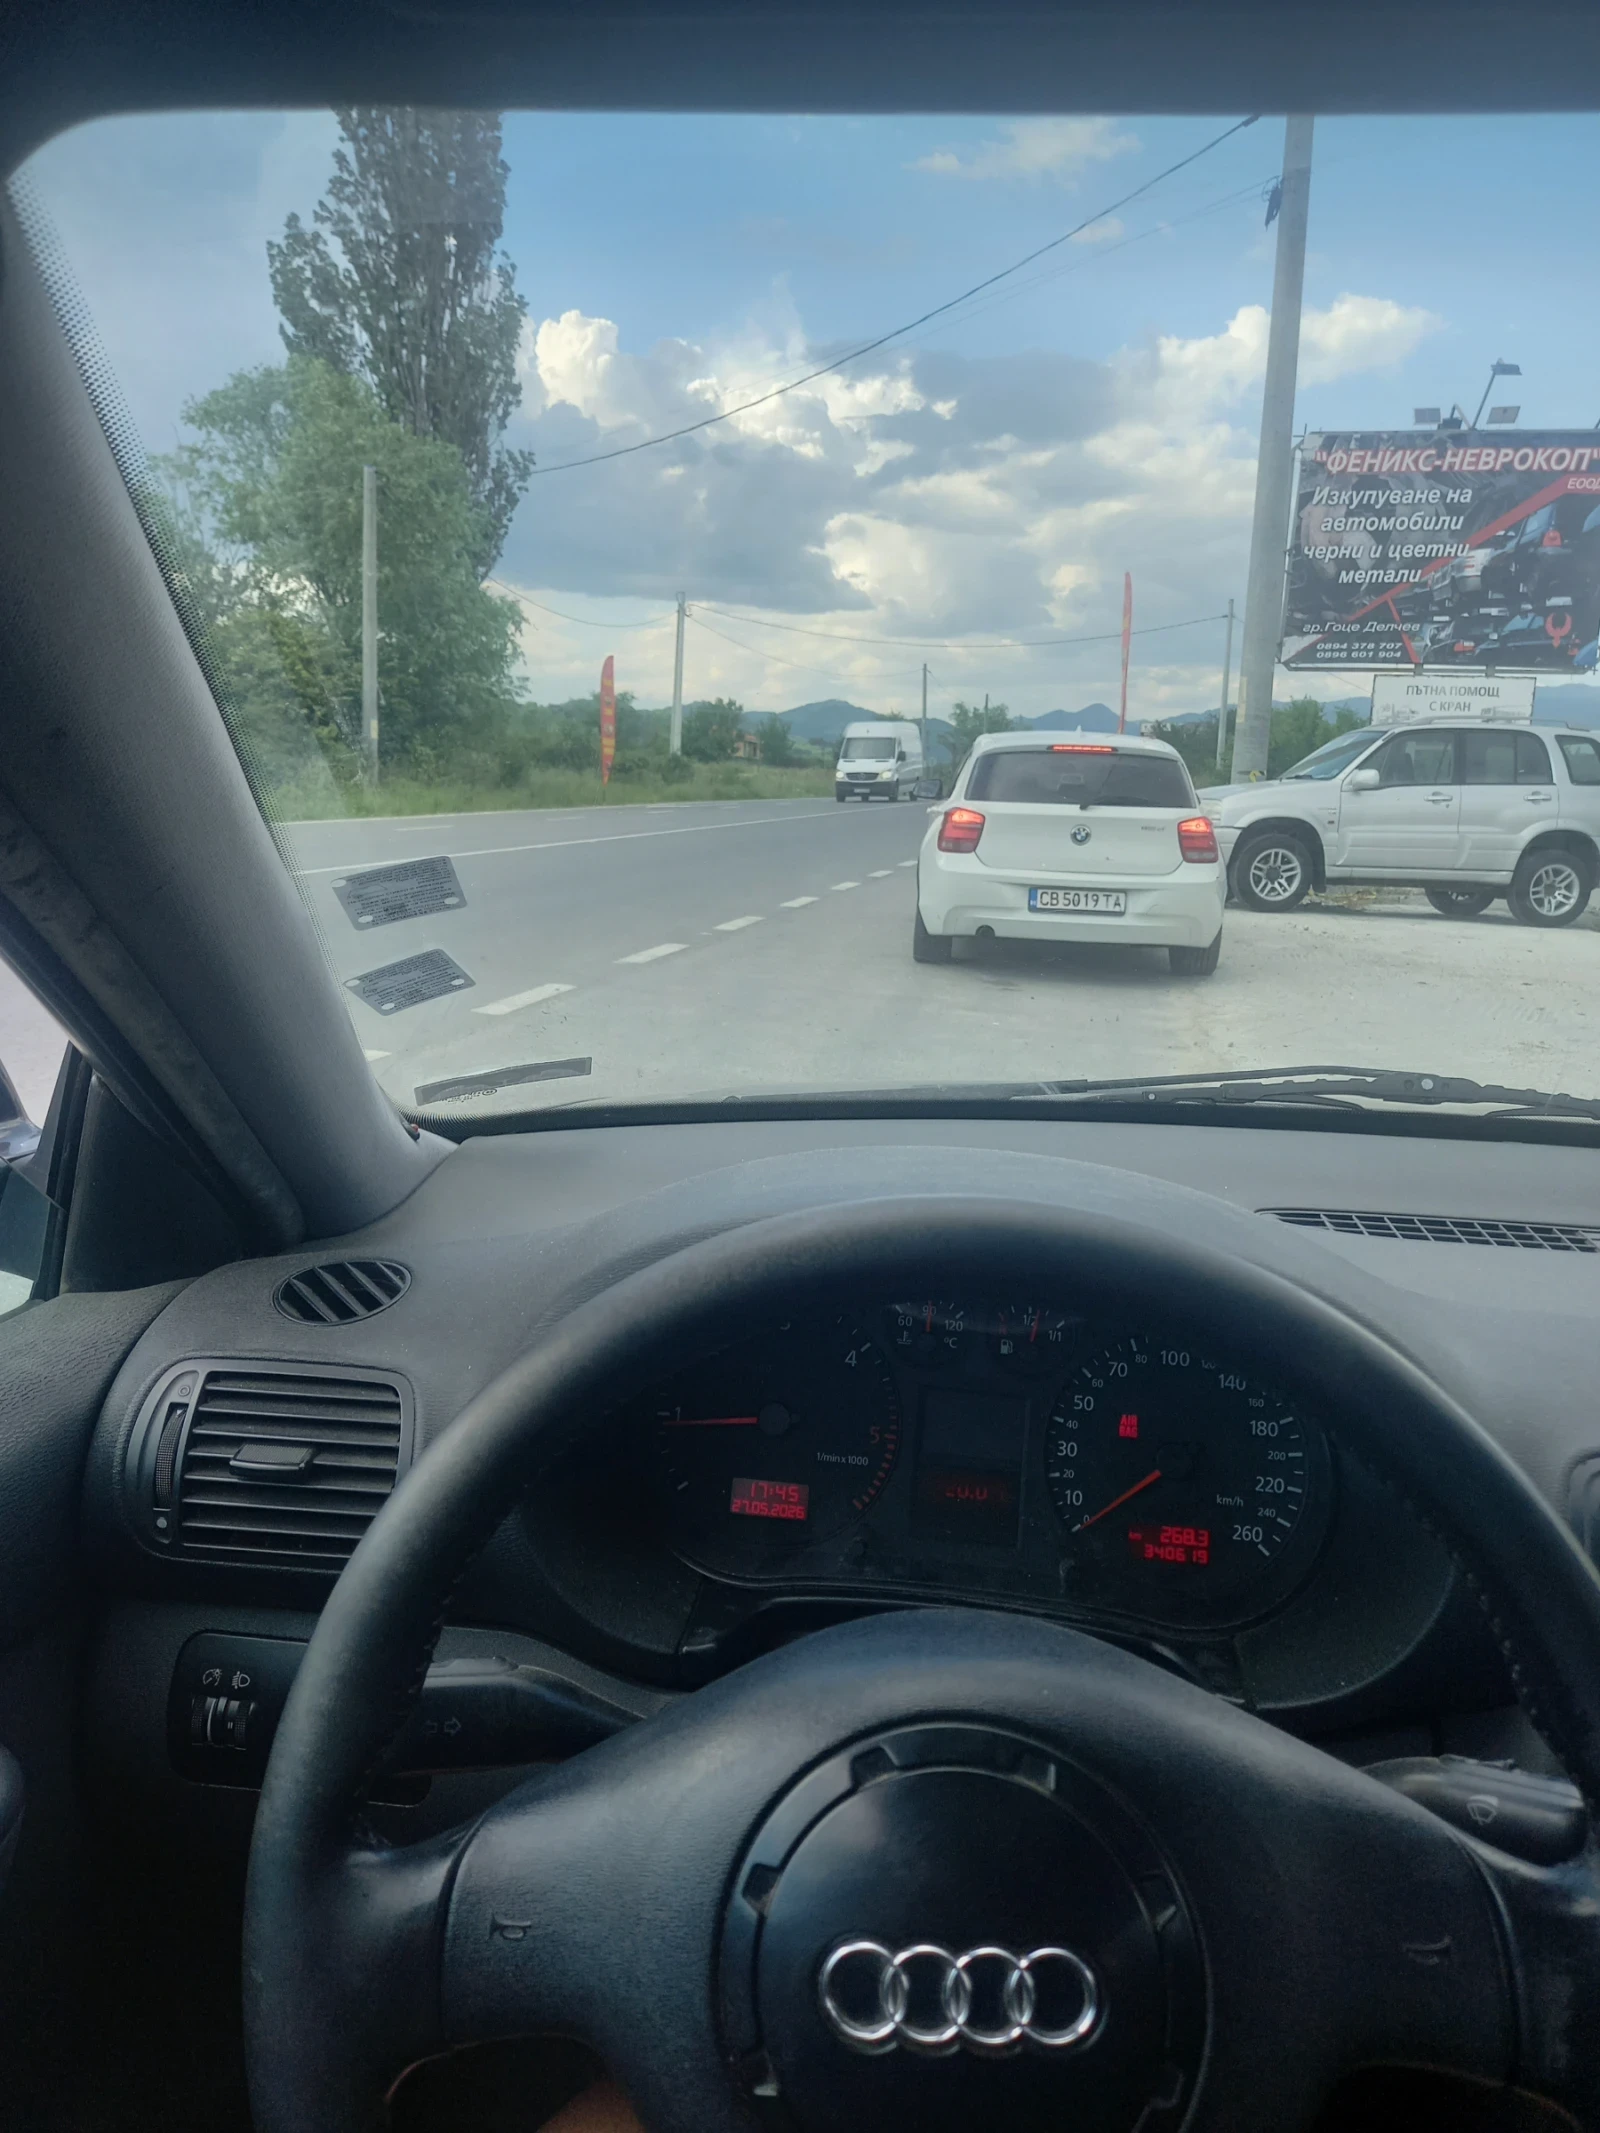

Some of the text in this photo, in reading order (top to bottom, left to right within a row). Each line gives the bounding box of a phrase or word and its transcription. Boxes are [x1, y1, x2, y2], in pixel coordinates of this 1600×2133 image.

[1312, 486, 1472, 508] Изкупуване на
[1320, 513, 1463, 532] автомобили
[1304, 542, 1469, 563] черни и цветни
[1338, 568, 1422, 584] метали
[1362, 621, 1420, 633] Делчев
[1316, 642, 1402, 650] 0894 378 707
[1351, 651, 1374, 659] 601
[1378, 651, 1401, 659] 904
[1406, 684, 1500, 698] ПЪТНА ПОМОЩ
[1429, 701, 1471, 712] С КРАН
[1039, 891, 1060, 907] CB
[1062, 892, 1100, 908] 5019
[1102, 894, 1122, 909] TA
[897, 1316, 913, 1327] 60
[944, 1320, 963, 1332] 120
[1048, 1330, 1062, 1342] 1/1
[844, 1350, 858, 1367] 4
[1135, 1354, 1148, 1364] 80
[1160, 1350, 1190, 1367] 100
[1108, 1361, 1128, 1378] 70
[1091, 1379, 1104, 1388] 60
[1073, 1395, 1095, 1412] 50
[1248, 1398, 1265, 1408] 160
[1066, 1419, 1079, 1430] 40
[1120, 1414, 1138, 1426] AIR
[869, 1426, 880, 1444] 5
[1118, 1426, 1138, 1438] BAG
[1249, 1420, 1279, 1438] 180
[1057, 1440, 1078, 1458] 30
[1267, 1450, 1287, 1461] 200
[847, 1454, 869, 1466] 1000
[1063, 1469, 1075, 1479] 20
[750, 1482, 799, 1502] 17:45
[1254, 1476, 1286, 1494] 220
[1065, 1489, 1084, 1506] 10
[1216, 1494, 1245, 1507] km/h
[731, 1499, 805, 1520] 27.05.2026
[1257, 1506, 1277, 1518] 240
[1160, 1525, 1210, 1547] 268.3
[1231, 1524, 1264, 1543] 260
